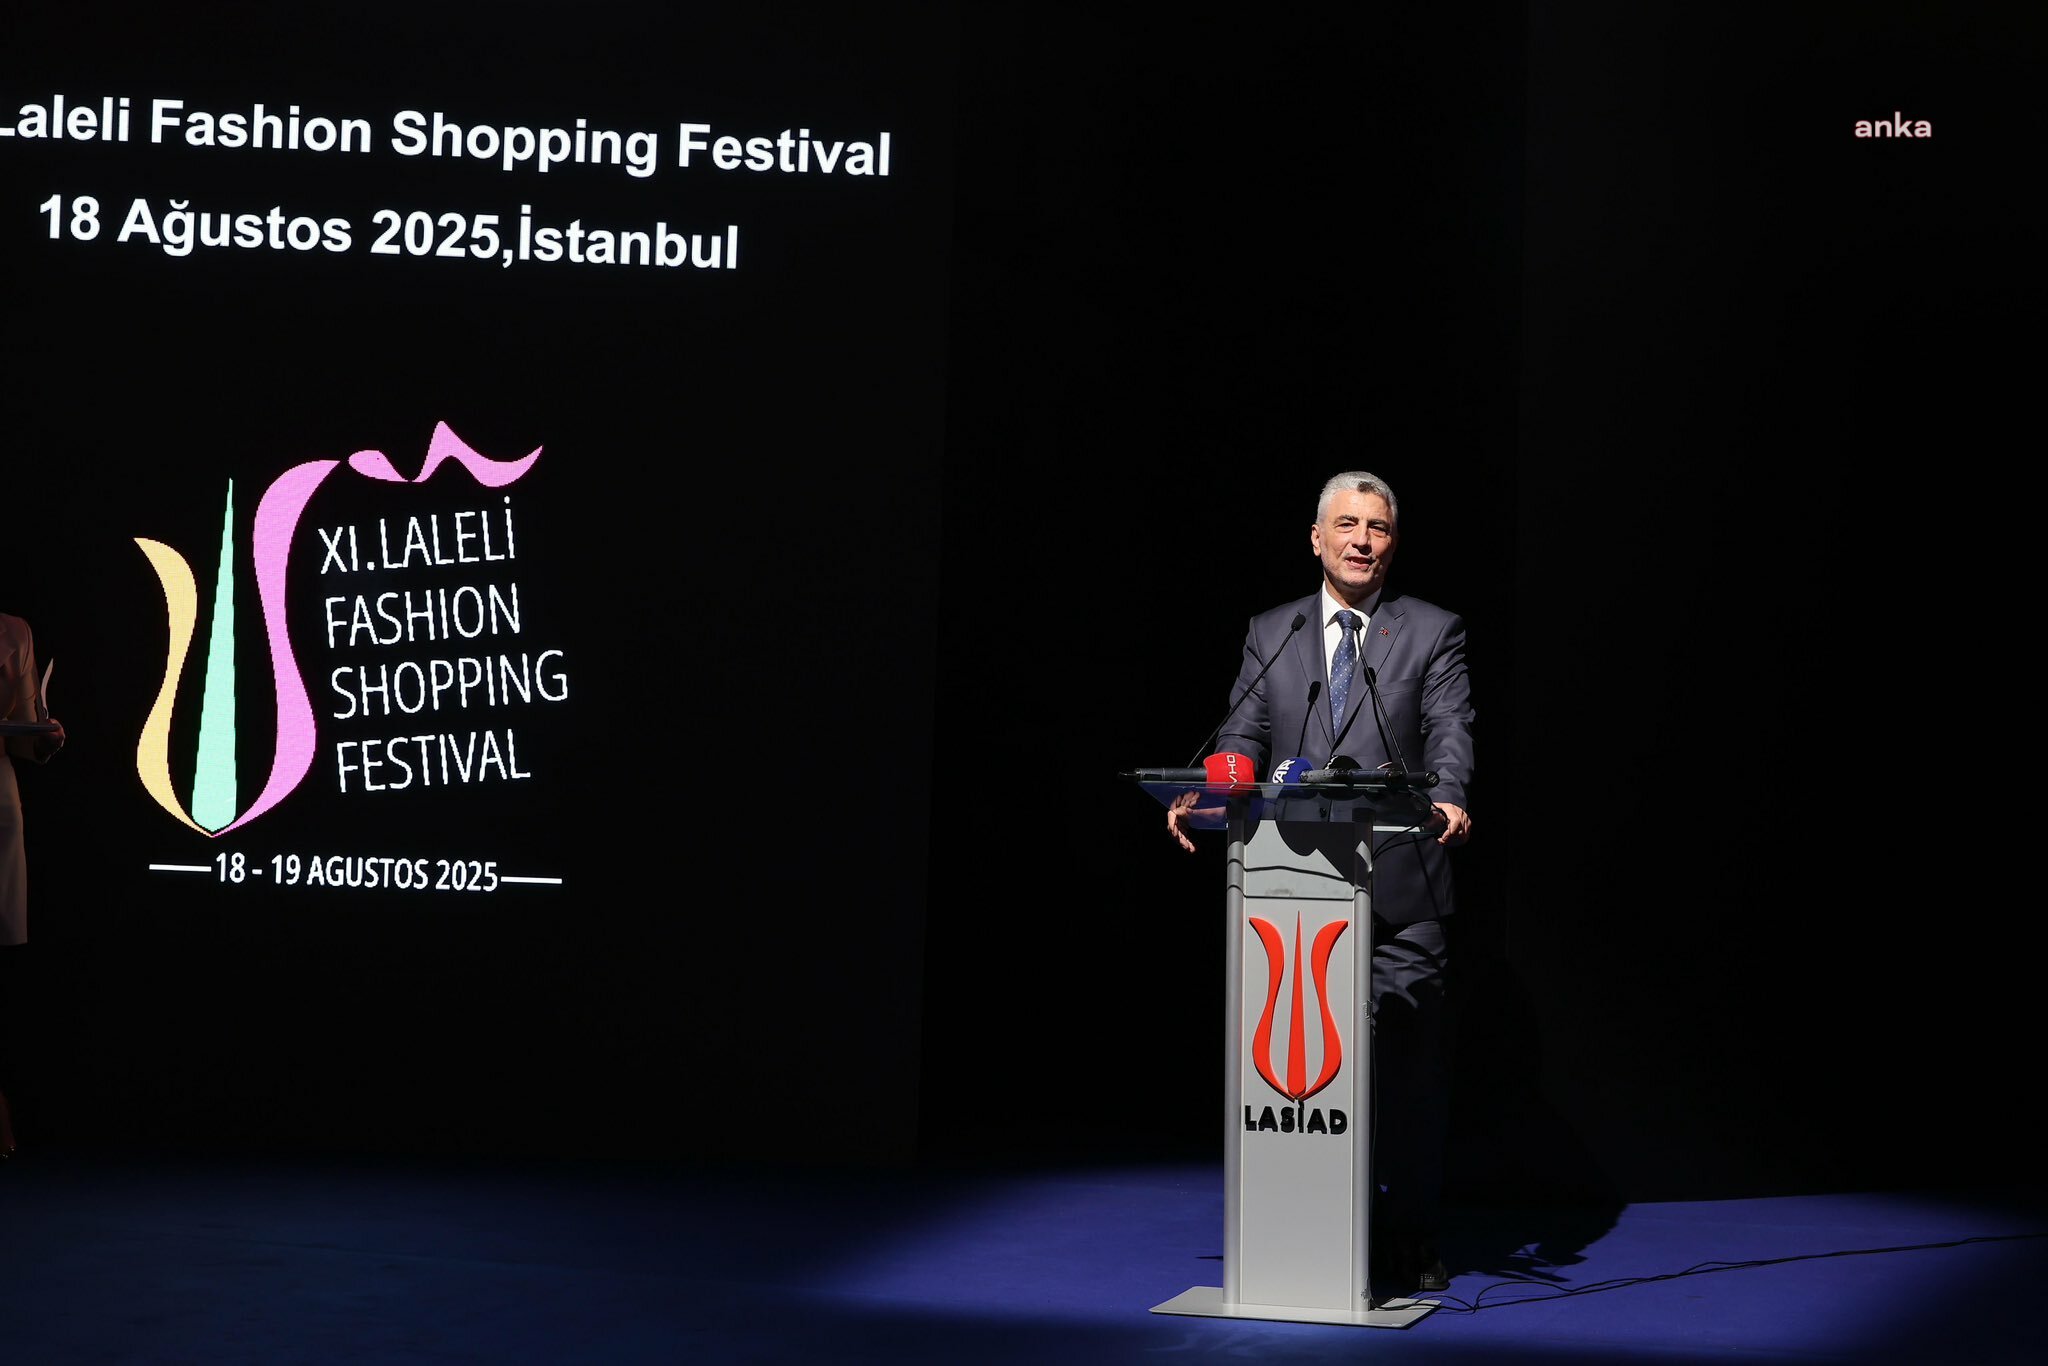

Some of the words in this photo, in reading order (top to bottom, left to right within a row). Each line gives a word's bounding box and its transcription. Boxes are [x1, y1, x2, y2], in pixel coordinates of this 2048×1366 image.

[151, 99, 372, 153] Fashion
[391, 111, 658, 178] Shopping
[678, 123, 891, 177] Festival
[39, 194, 101, 240] 18
[117, 199, 352, 257] Ağustos
[325, 583, 521, 649] FASHION
[331, 649, 569, 720] SHOPPING
[336, 728, 531, 793] FESTIVAL
[215, 852, 246, 884] 18
[271, 854, 302, 886] 19
[306, 856, 429, 890] AGUSTOS
[435, 859, 498, 892] 2025
